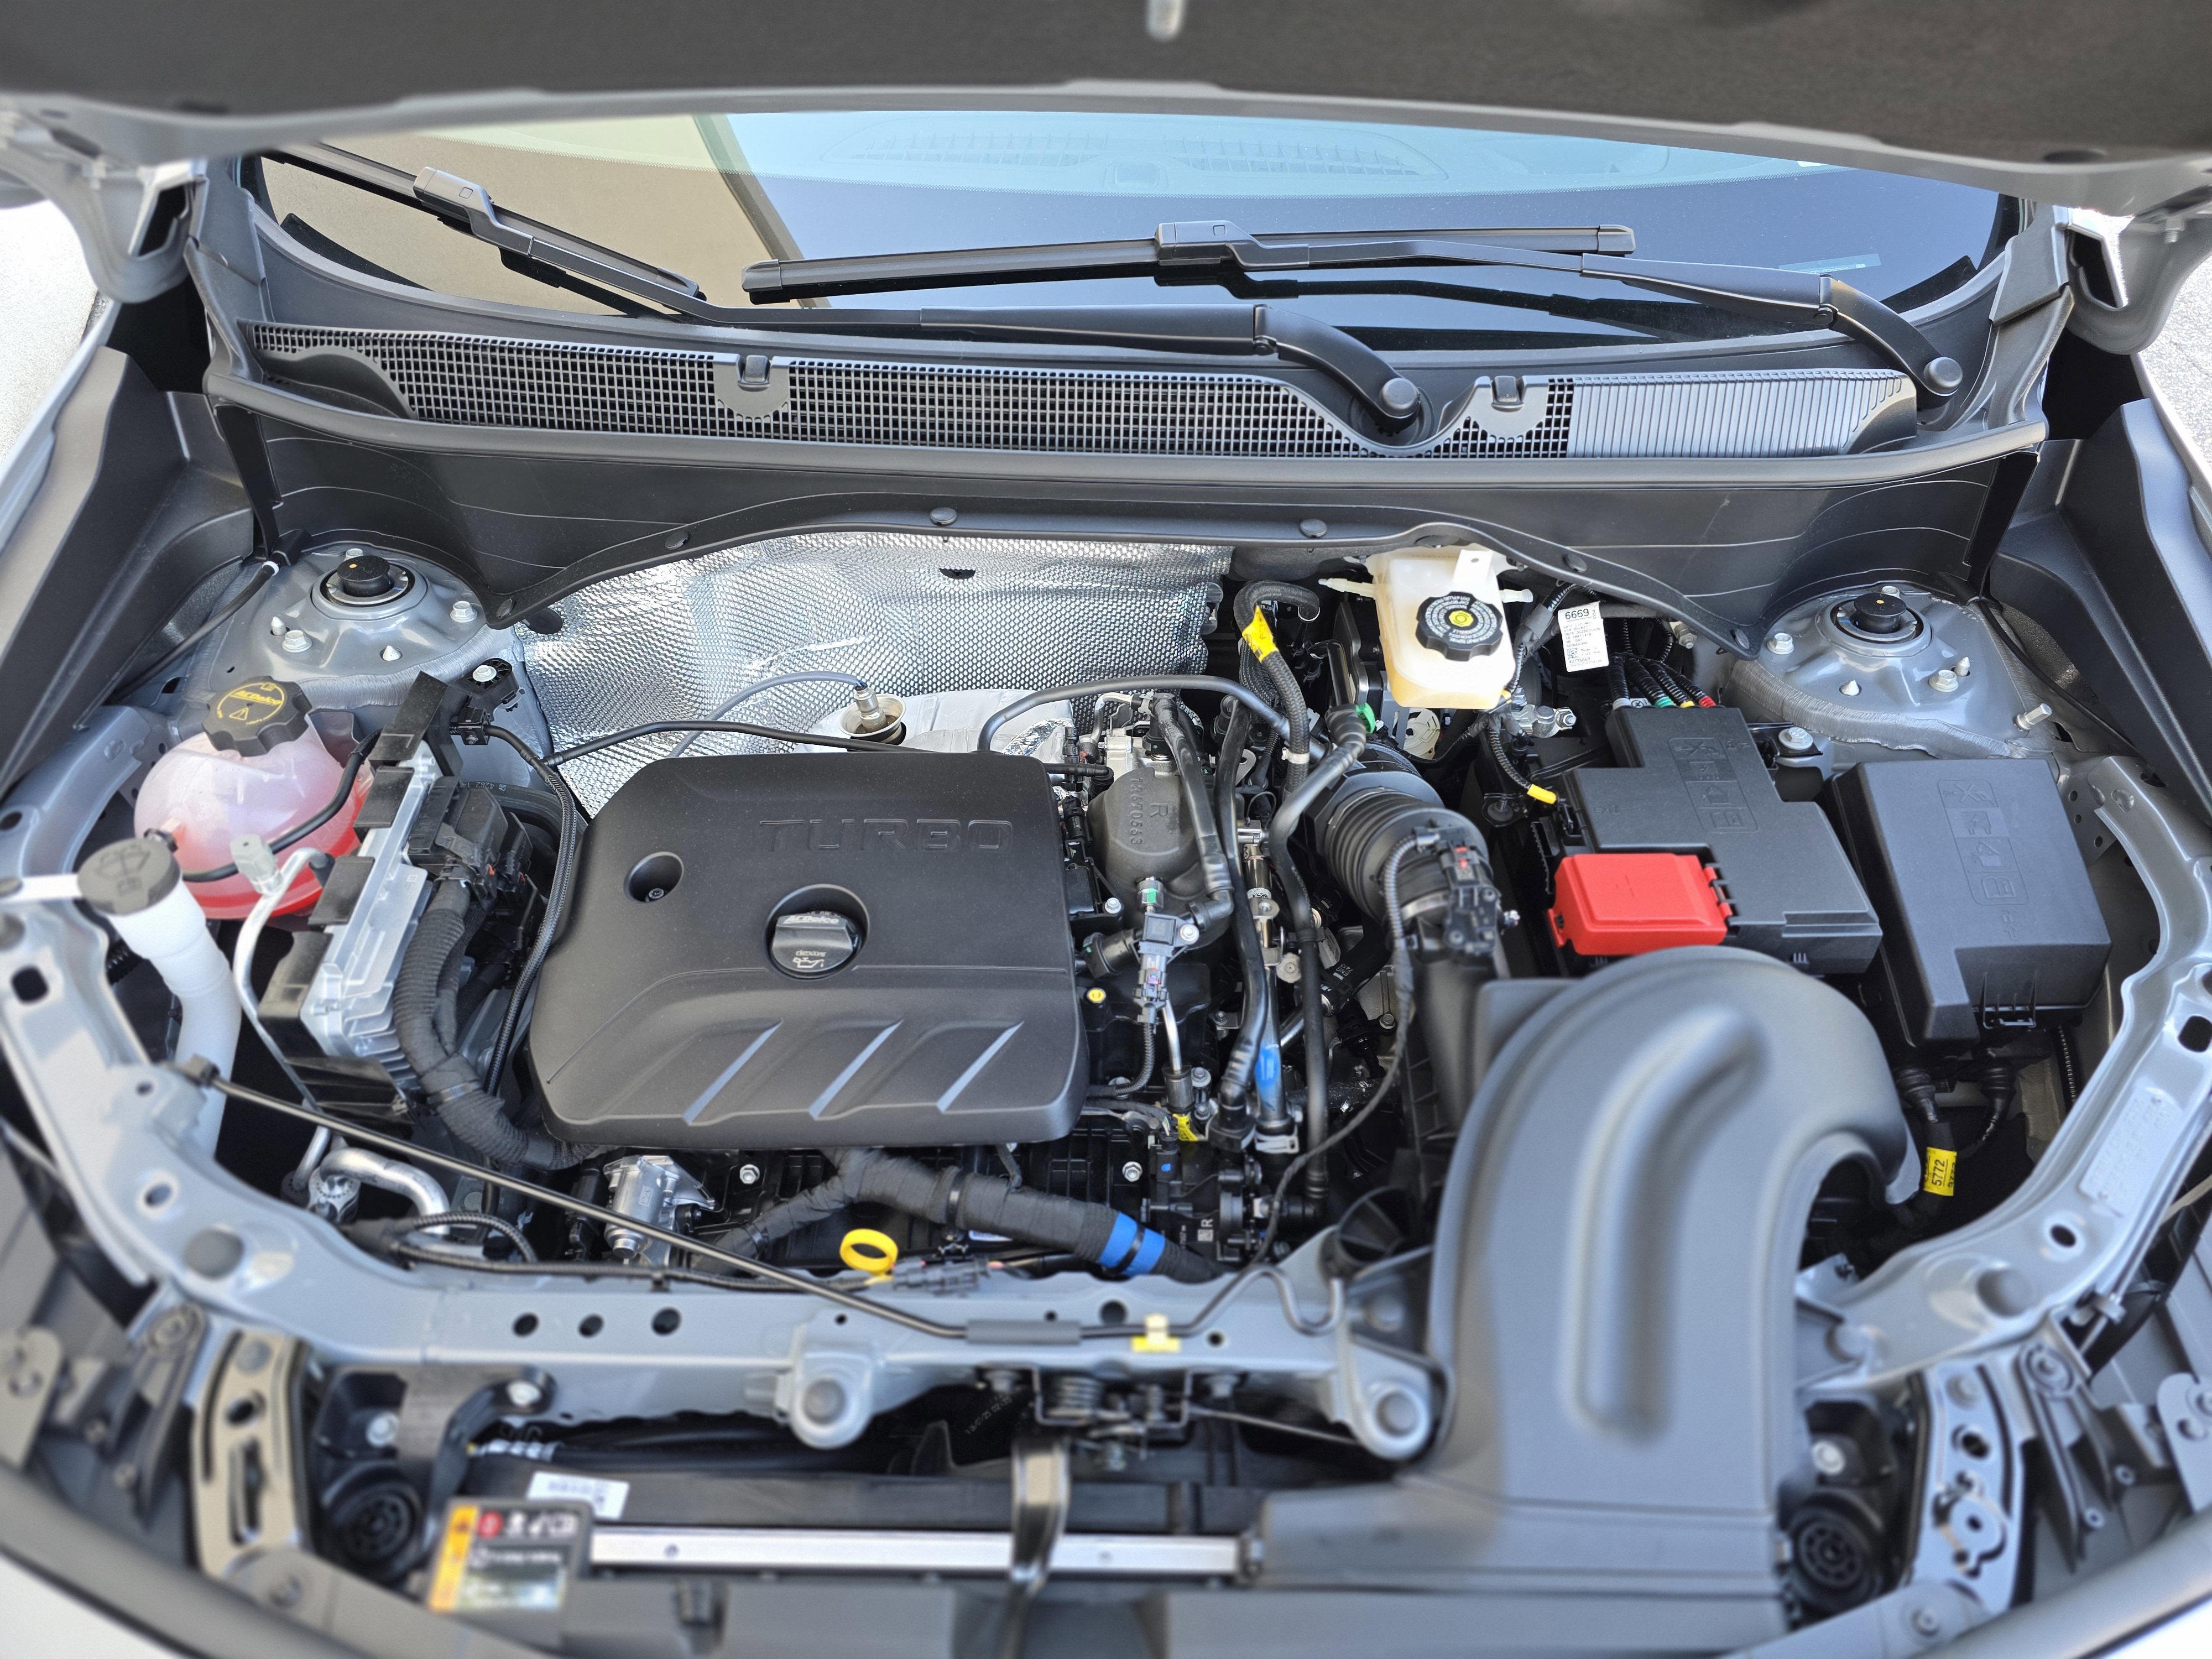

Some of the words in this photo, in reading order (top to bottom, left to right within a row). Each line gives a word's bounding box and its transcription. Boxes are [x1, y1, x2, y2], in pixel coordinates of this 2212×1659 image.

[1565, 608, 1589, 620] 6669
[229, 691, 282, 706] ACDelco
[476, 781, 495, 790] 4282
[1150, 802, 1168, 817] R
[759, 819, 1013, 852] TURBO
[783, 915, 840, 925] ACDelco
[1335, 967, 1349, 977] ENG
[1931, 1159, 1945, 1186] 5772
[1201, 1218, 1213, 1227] R
